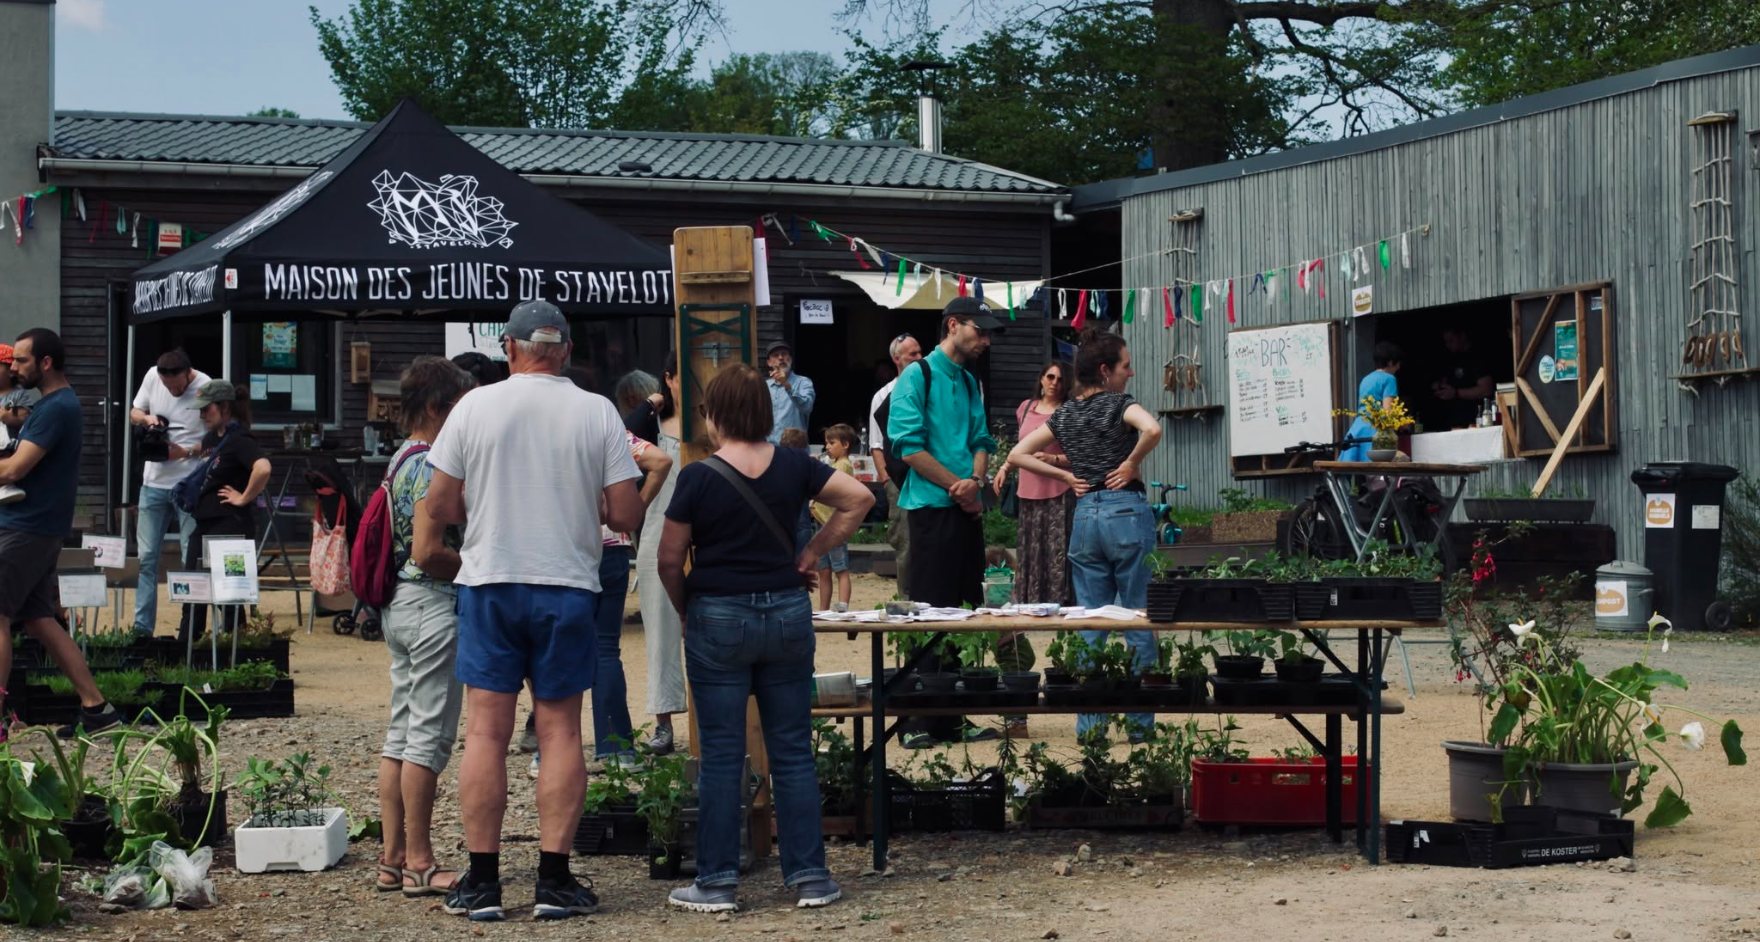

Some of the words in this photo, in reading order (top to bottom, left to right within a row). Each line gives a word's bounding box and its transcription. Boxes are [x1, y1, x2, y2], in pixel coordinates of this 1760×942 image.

[264, 263, 358, 300] MAISON
[367, 267, 412, 300] DES
[422, 262, 509, 300] JEUNES
[518, 267, 546, 301] DE
[555, 269, 672, 304] STAVELOT
[1260, 338, 1288, 367] BAR
[1541, 848, 1550, 857] DE
[1551, 846, 1577, 856] KOSTER
